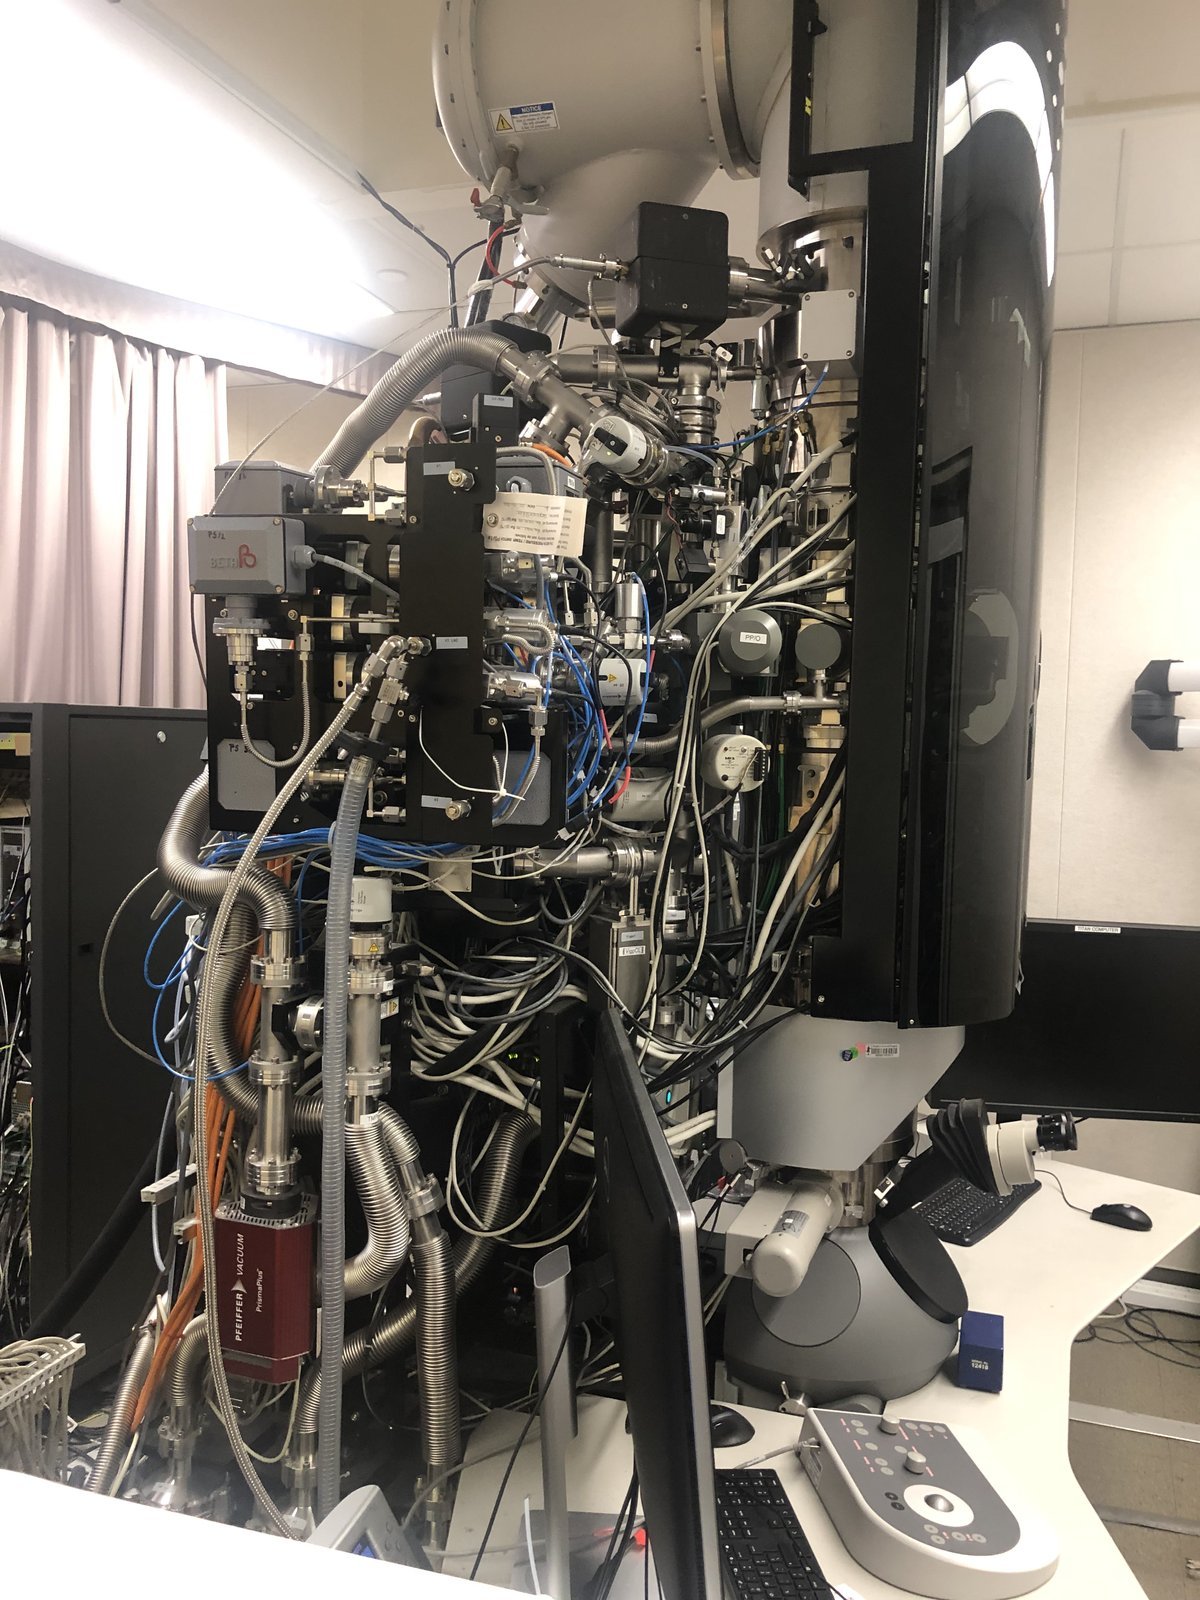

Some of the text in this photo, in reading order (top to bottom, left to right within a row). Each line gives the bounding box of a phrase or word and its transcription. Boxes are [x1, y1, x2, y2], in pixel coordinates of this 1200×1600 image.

[521, 105, 542, 113] NOTICE
[235, 1233, 245, 1342] PFEIFFER VACUUM
